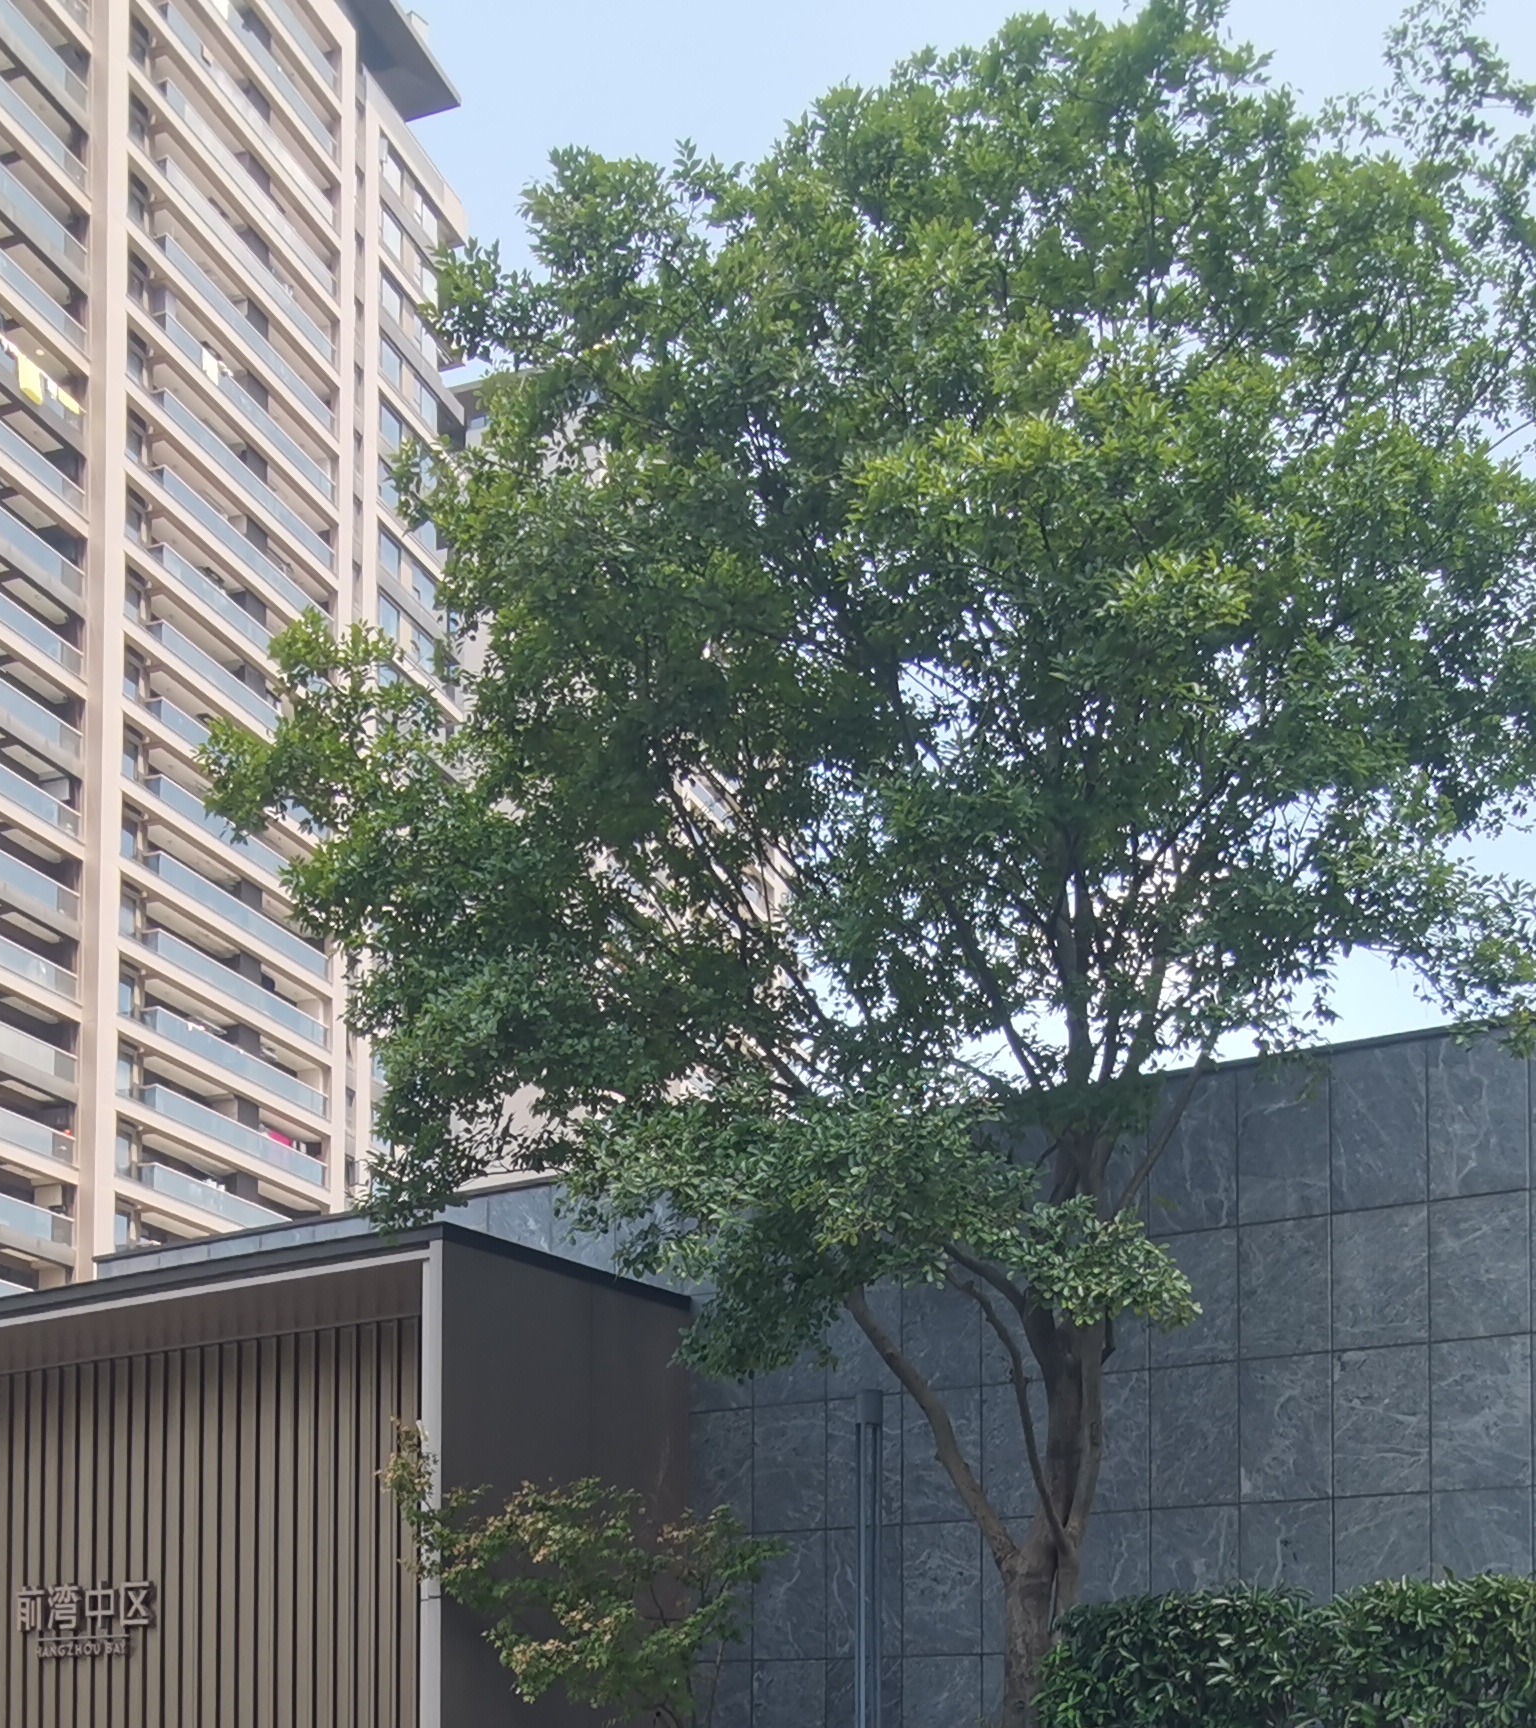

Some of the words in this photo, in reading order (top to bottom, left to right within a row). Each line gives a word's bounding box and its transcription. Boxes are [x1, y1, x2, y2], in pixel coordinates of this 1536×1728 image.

[16, 1580, 150, 1631] 前湾中区
[35, 1641, 101, 1658] HANGZHOU
[105, 1639, 126, 1654] BAY
